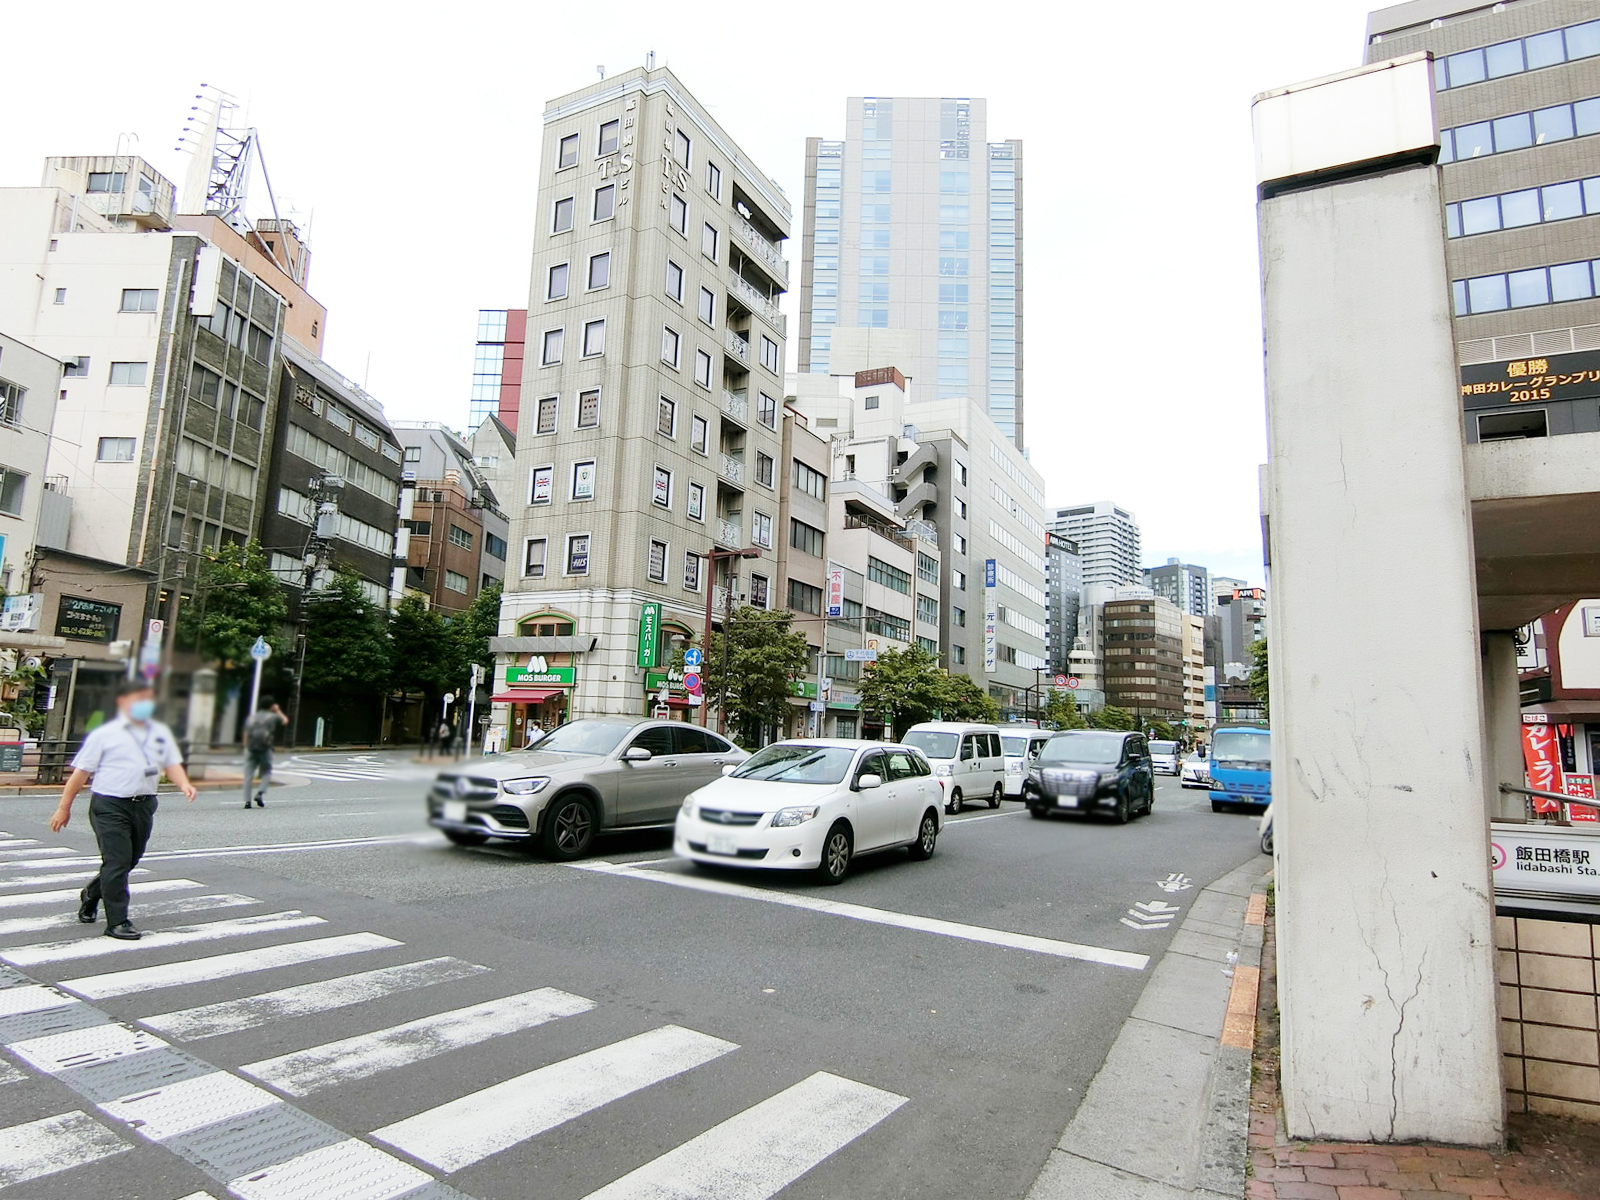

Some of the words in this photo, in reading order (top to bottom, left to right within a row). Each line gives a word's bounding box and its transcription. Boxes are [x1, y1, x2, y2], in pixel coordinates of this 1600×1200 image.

[1507, 359, 1549, 378] 優勝
[1461, 370, 1600, 396] 神田カレーグランプリ
[1510, 388, 1551, 402] 2015
[987, 562, 995, 584] 診療所
[831, 571, 841, 605] 不動産
[643, 616, 653, 664] モスバーガー
[985, 612, 995, 667] 元気プラザ
[517, 674, 534, 682] MOS
[534, 674, 562, 682] BURGER
[669, 682, 685, 690] BURG
[1515, 845, 1590, 865] 飯田橋駅
[1516, 861, 1573, 874] Iidabashi
